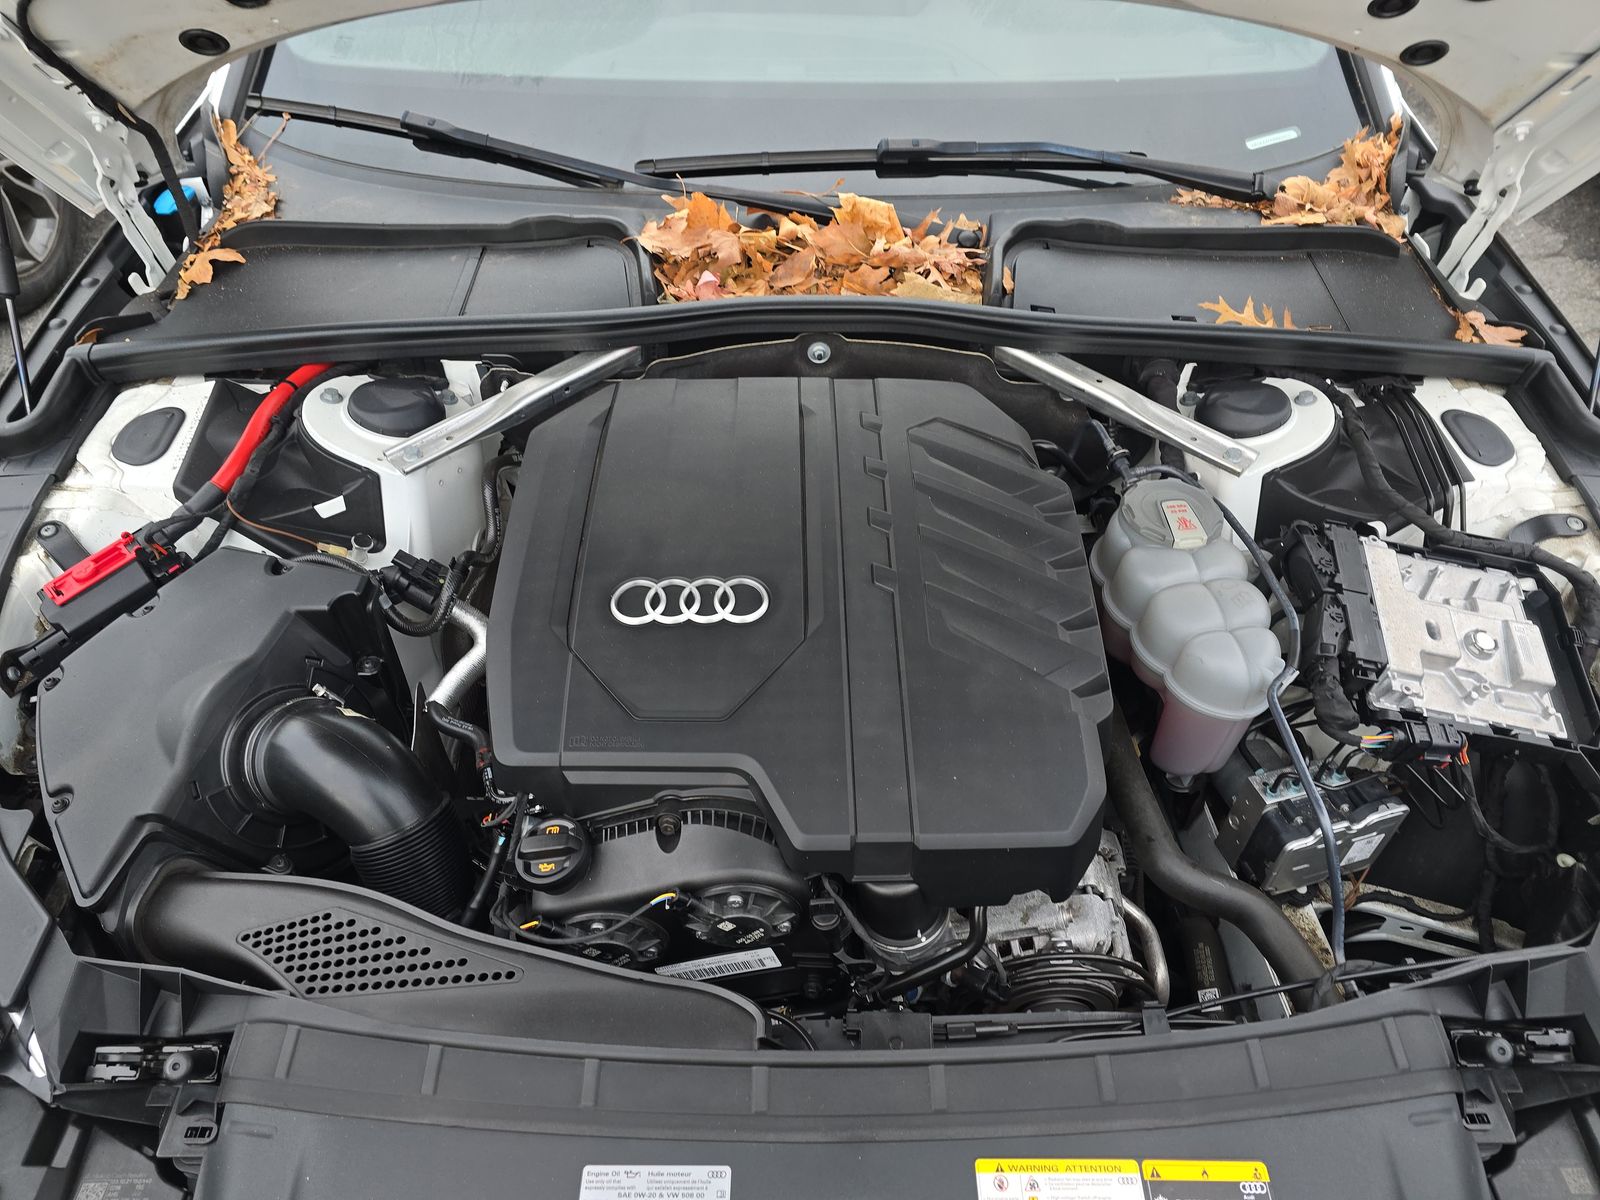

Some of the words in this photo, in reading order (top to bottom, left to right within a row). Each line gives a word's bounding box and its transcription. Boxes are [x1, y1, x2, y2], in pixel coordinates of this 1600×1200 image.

[1008, 1164, 1059, 1173] WARNING
[1065, 1164, 1122, 1173] ATTENTION
[586, 1170, 609, 1178] Engine
